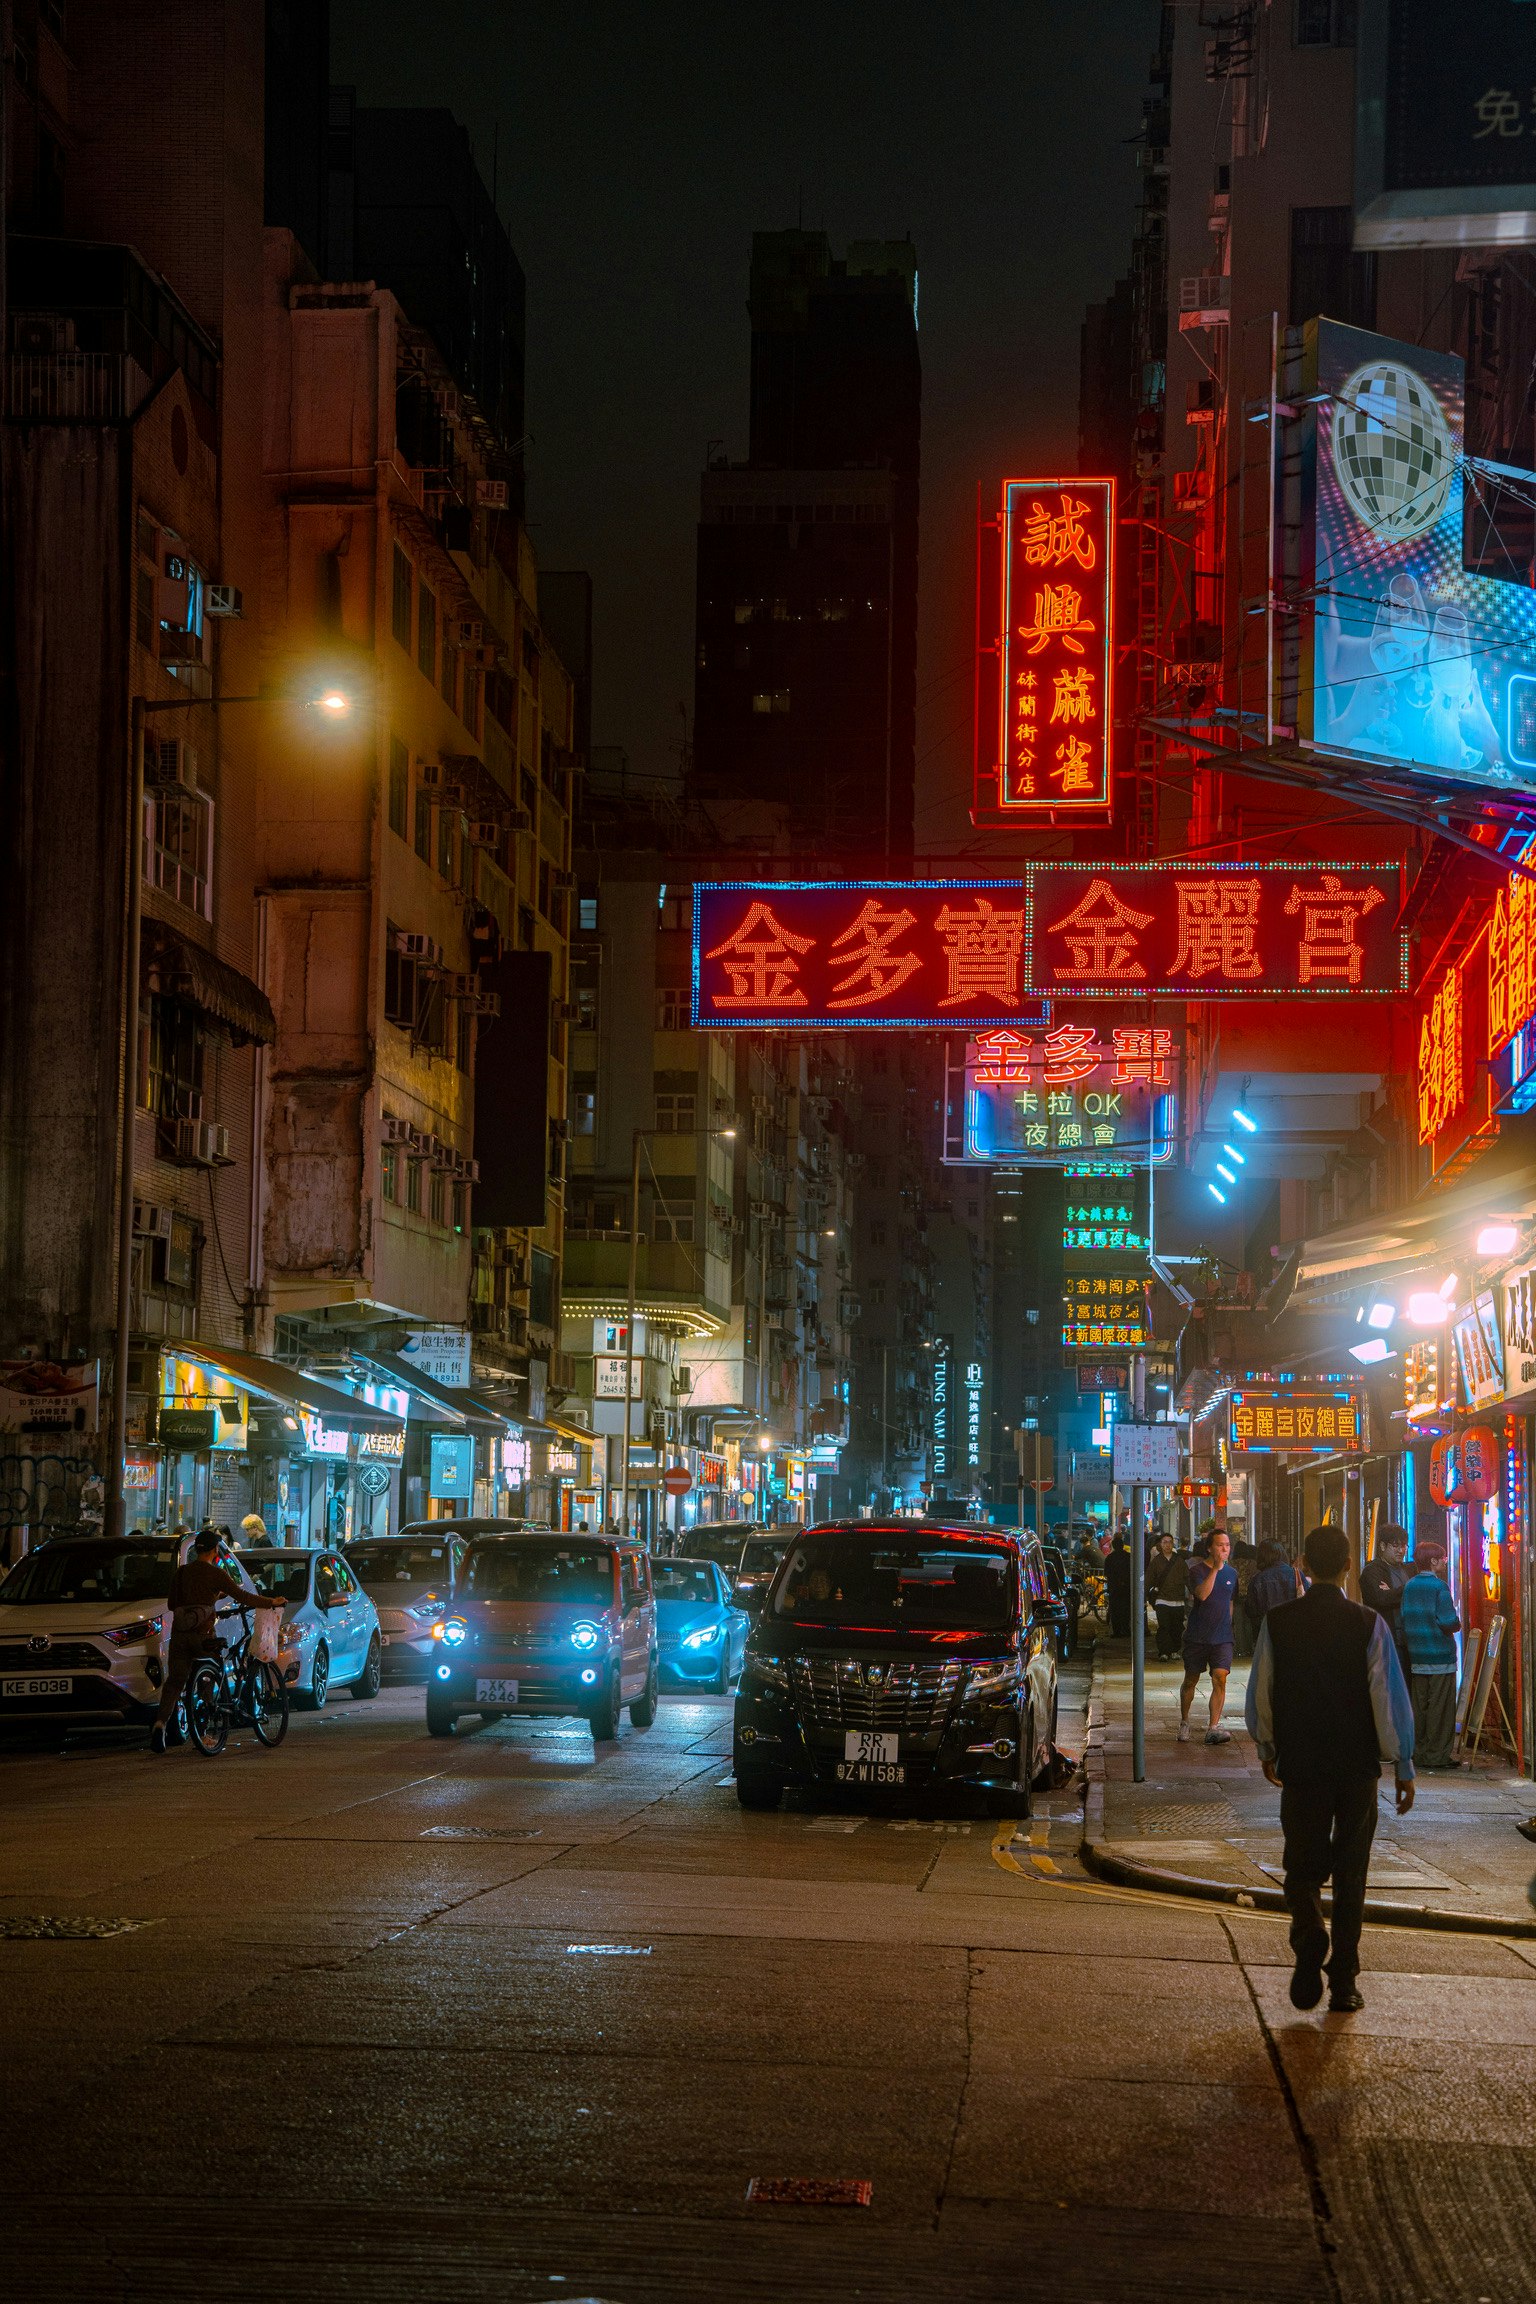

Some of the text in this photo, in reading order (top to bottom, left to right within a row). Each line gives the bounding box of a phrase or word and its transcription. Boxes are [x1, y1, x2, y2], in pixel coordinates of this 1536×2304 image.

[705, 898, 1025, 1008] 金多寶
[975, 1024, 1171, 1086] 金多寶
[1025, 1123, 1116, 1147] 夜總會
[421, 1336, 466, 1348] 億生物業
[619, 1386, 634, 1394] 822
[934, 1361, 946, 1473] TUNG NAM LOU
[6, 1680, 69, 1694] KE 6038
[489, 1680, 506, 1691] XK
[480, 1691, 516, 1702] 2646
[861, 1733, 883, 1747] RR
[858, 1747, 887, 1761] 2111
